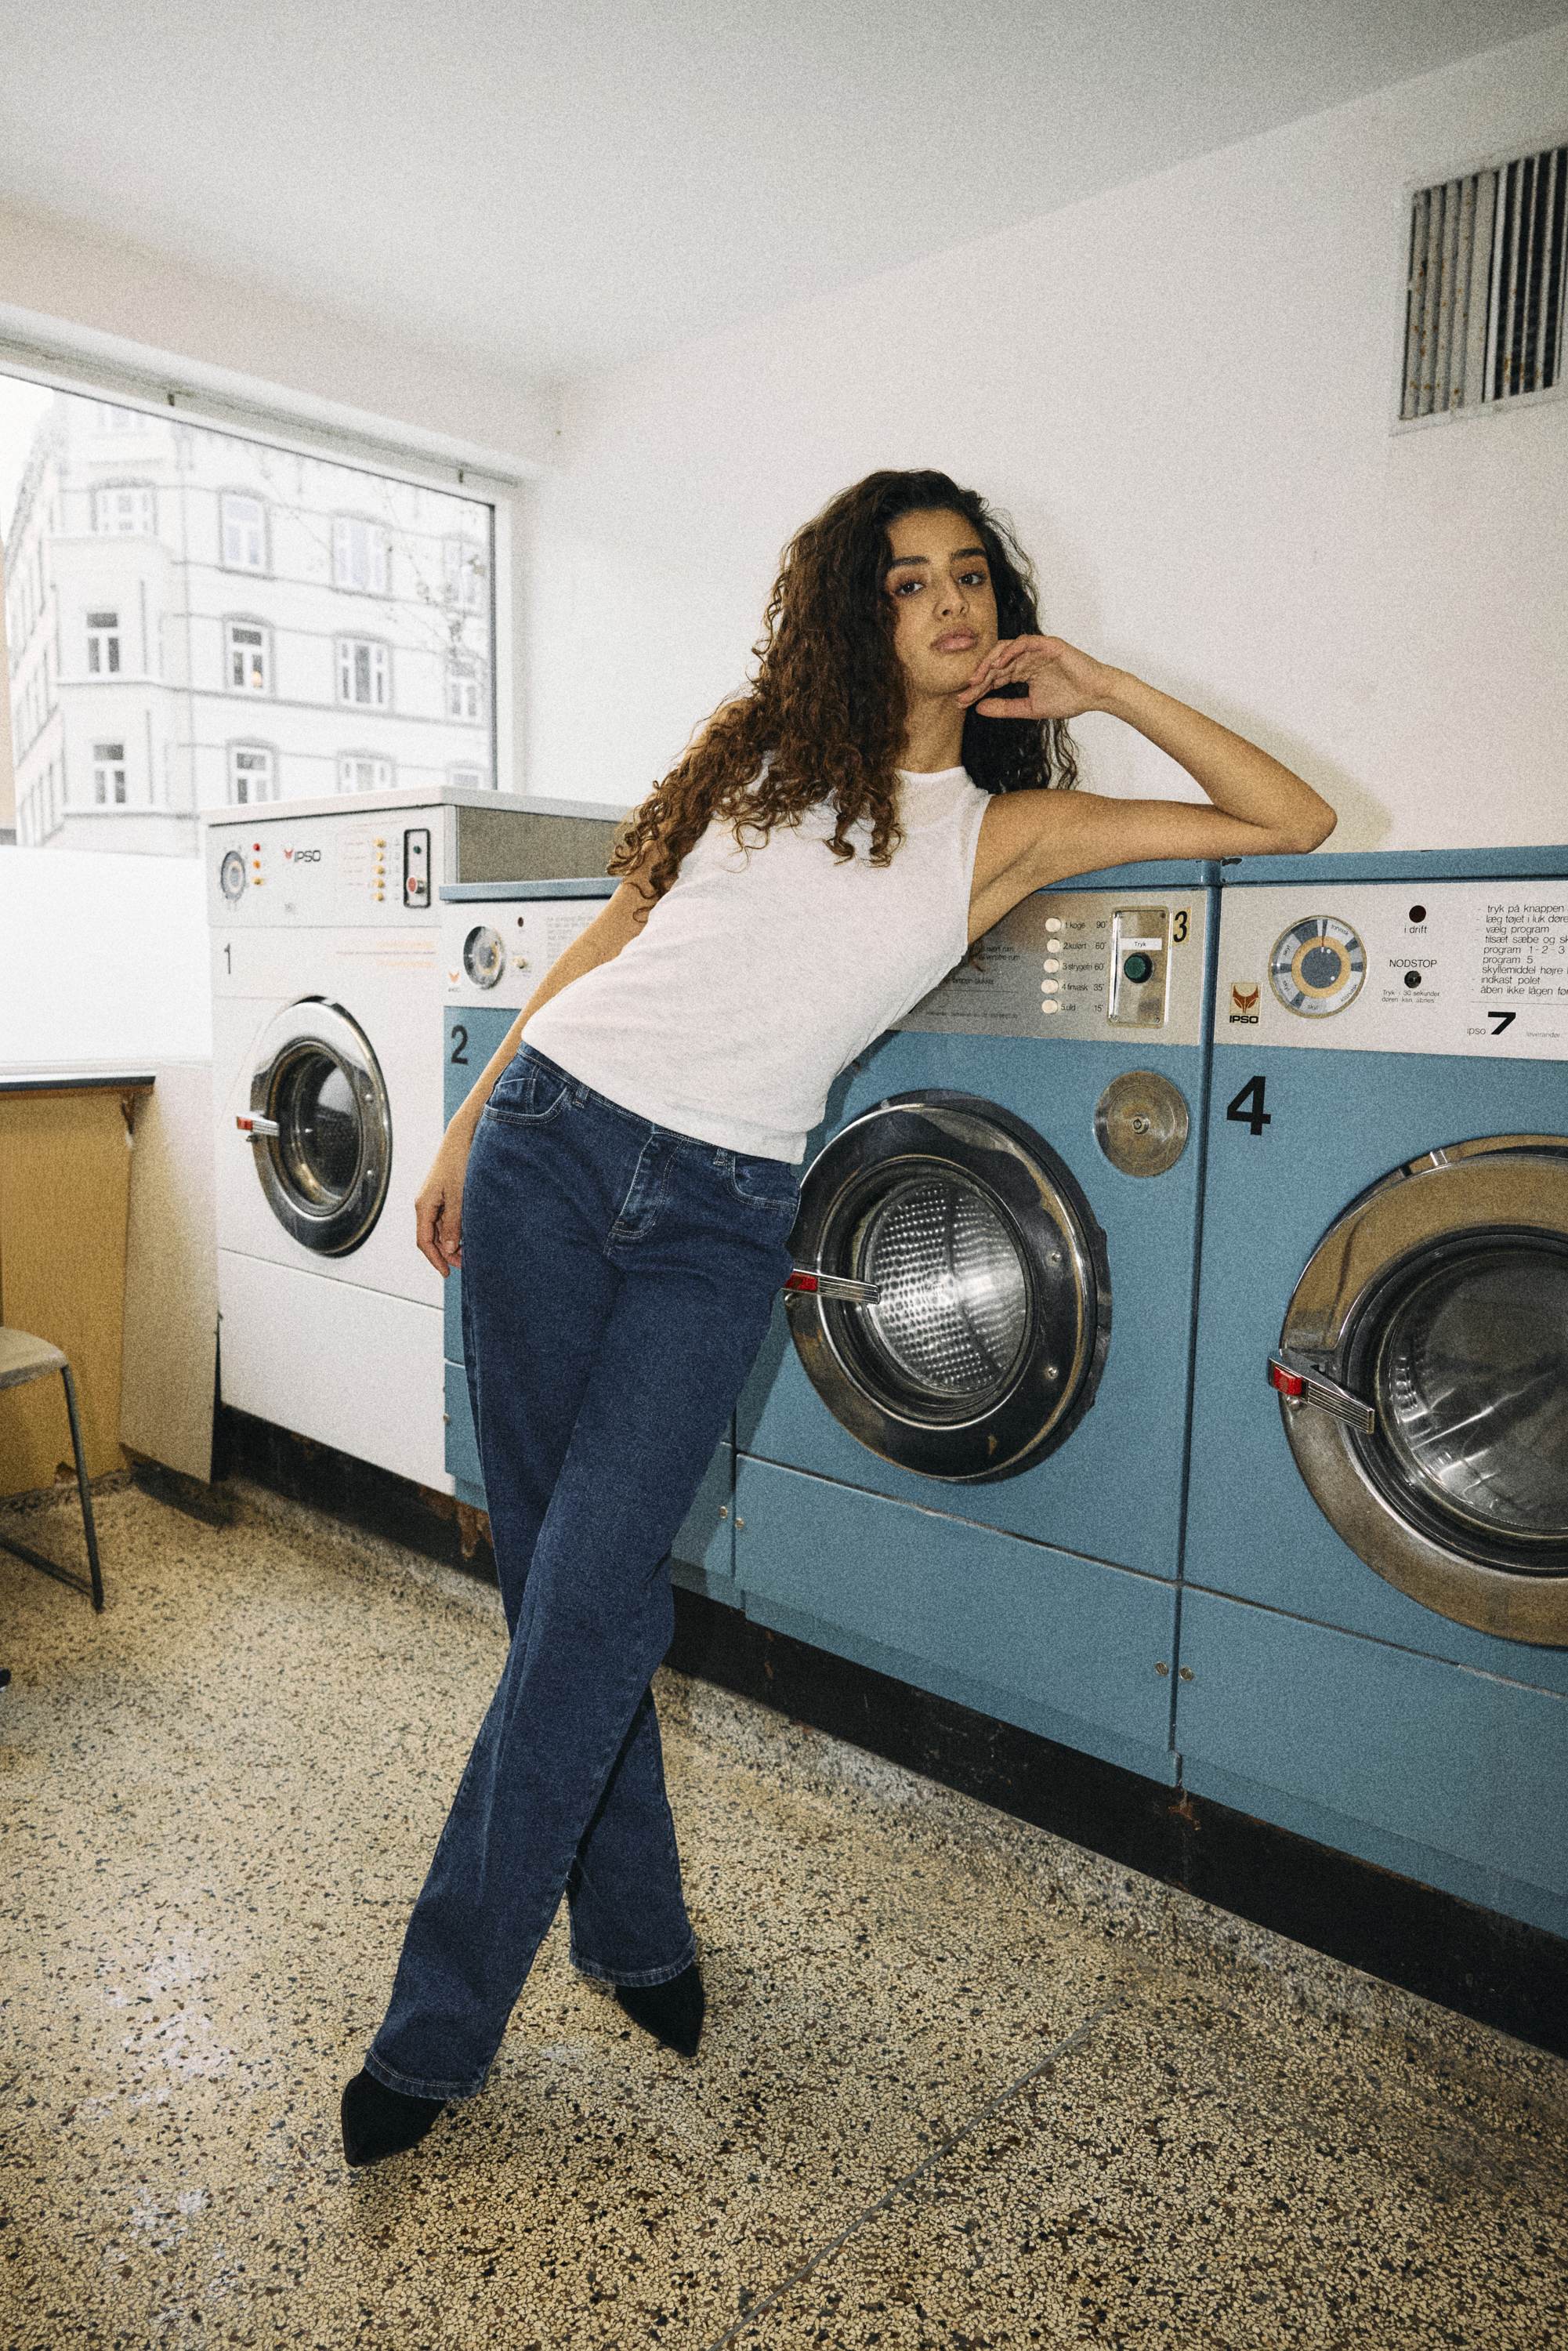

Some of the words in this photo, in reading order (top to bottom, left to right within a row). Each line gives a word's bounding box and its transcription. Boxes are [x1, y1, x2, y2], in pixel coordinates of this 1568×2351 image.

[295, 849, 320, 862] IPSO
[1487, 904, 1505, 915] tryk
[1508, 904, 1519, 914] på
[1523, 904, 1565, 914] knappen
[1486, 915, 1503, 925] læg
[1505, 915, 1524, 924] tøjet
[1532, 915, 1545, 923] luk
[1173, 911, 1188, 943] 3
[1409, 926, 1428, 934] drift
[1486, 926, 1507, 935] vælg
[1511, 926, 1550, 935] program
[1485, 935, 1508, 944] tilsæt
[1512, 935, 1539, 944] sæbe
[1543, 936, 1555, 945] og
[1483, 946, 1522, 955] program
[223, 944, 231, 975] 1
[1483, 956, 1521, 965] program
[1526, 955, 1534, 964] 5
[1482, 965, 1536, 975] skyllemiddel
[1541, 966, 1564, 976] højre
[1481, 975, 1512, 984] indkast
[1518, 976, 1541, 985] polet
[1480, 985, 1504, 994] åben
[1506, 986, 1525, 994] ikke
[1528, 986, 1553, 997] lågen
[1229, 1015, 1259, 1024] IPSO
[1467, 1027, 1487, 1036] ipso
[1487, 1011, 1517, 1035] 7
[451, 1024, 469, 1065] 2
[1226, 1075, 1272, 1136] 4
